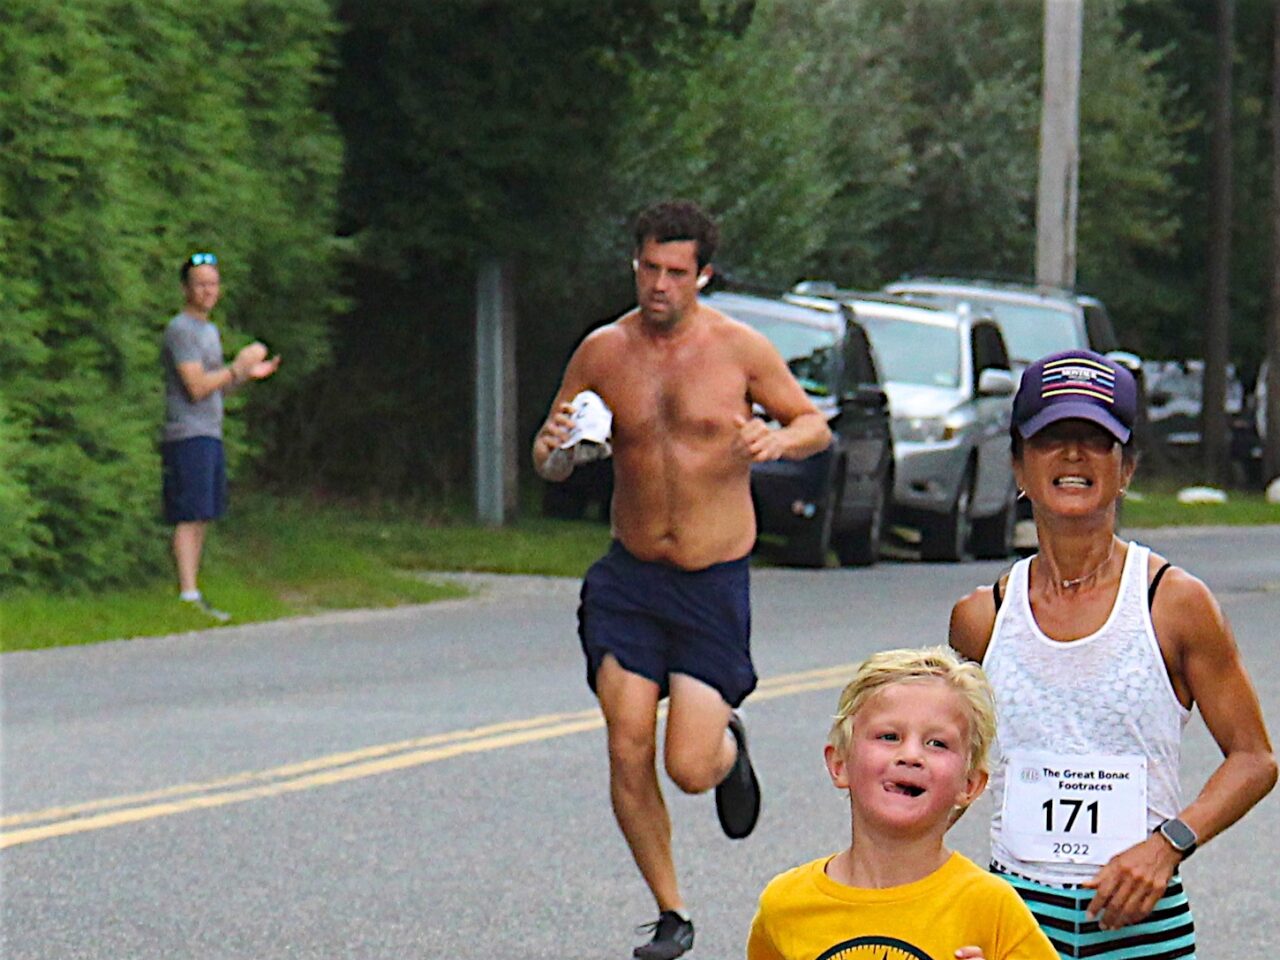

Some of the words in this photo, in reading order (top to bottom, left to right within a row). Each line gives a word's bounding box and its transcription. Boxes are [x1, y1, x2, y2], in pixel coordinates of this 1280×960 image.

[1043, 768, 1061, 778] The
[1063, 769, 1095, 780] Great
[1098, 771, 1130, 780] Bonac
[1058, 781, 1113, 791] Footraces
[1042, 799, 1098, 834] 171
[1052, 843, 1089, 855] 2022
